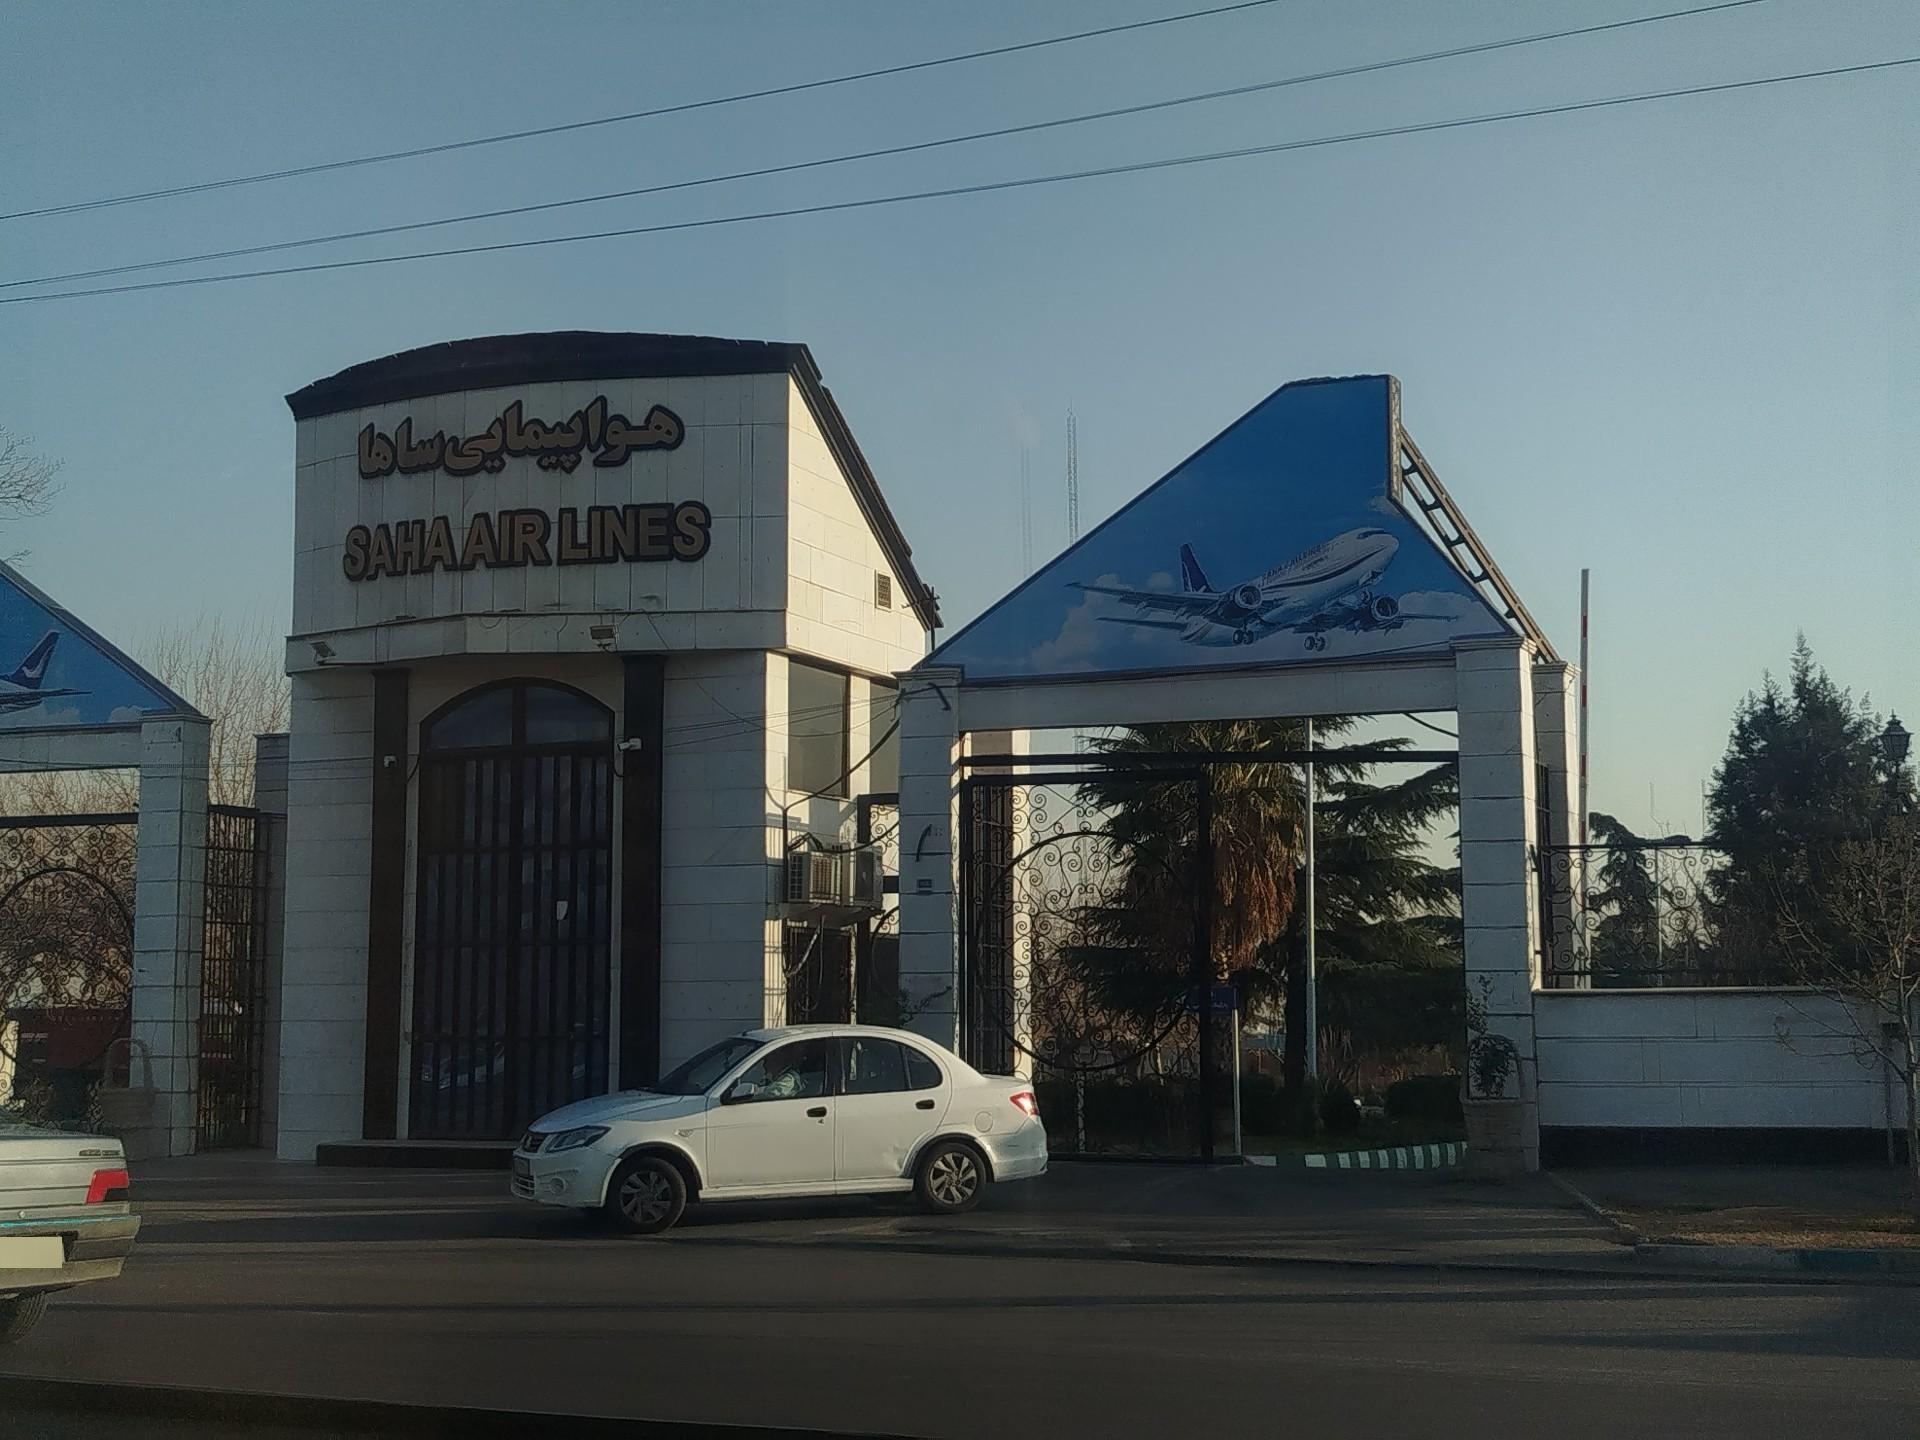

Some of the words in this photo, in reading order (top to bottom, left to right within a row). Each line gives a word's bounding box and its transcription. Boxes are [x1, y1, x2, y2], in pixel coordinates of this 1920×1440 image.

[358, 416, 446, 479] ساها
[444, 395, 685, 476] هواپیمایی
[343, 515, 458, 581] SAHA
[459, 508, 553, 570] AIR
[557, 500, 712, 565] LINES
